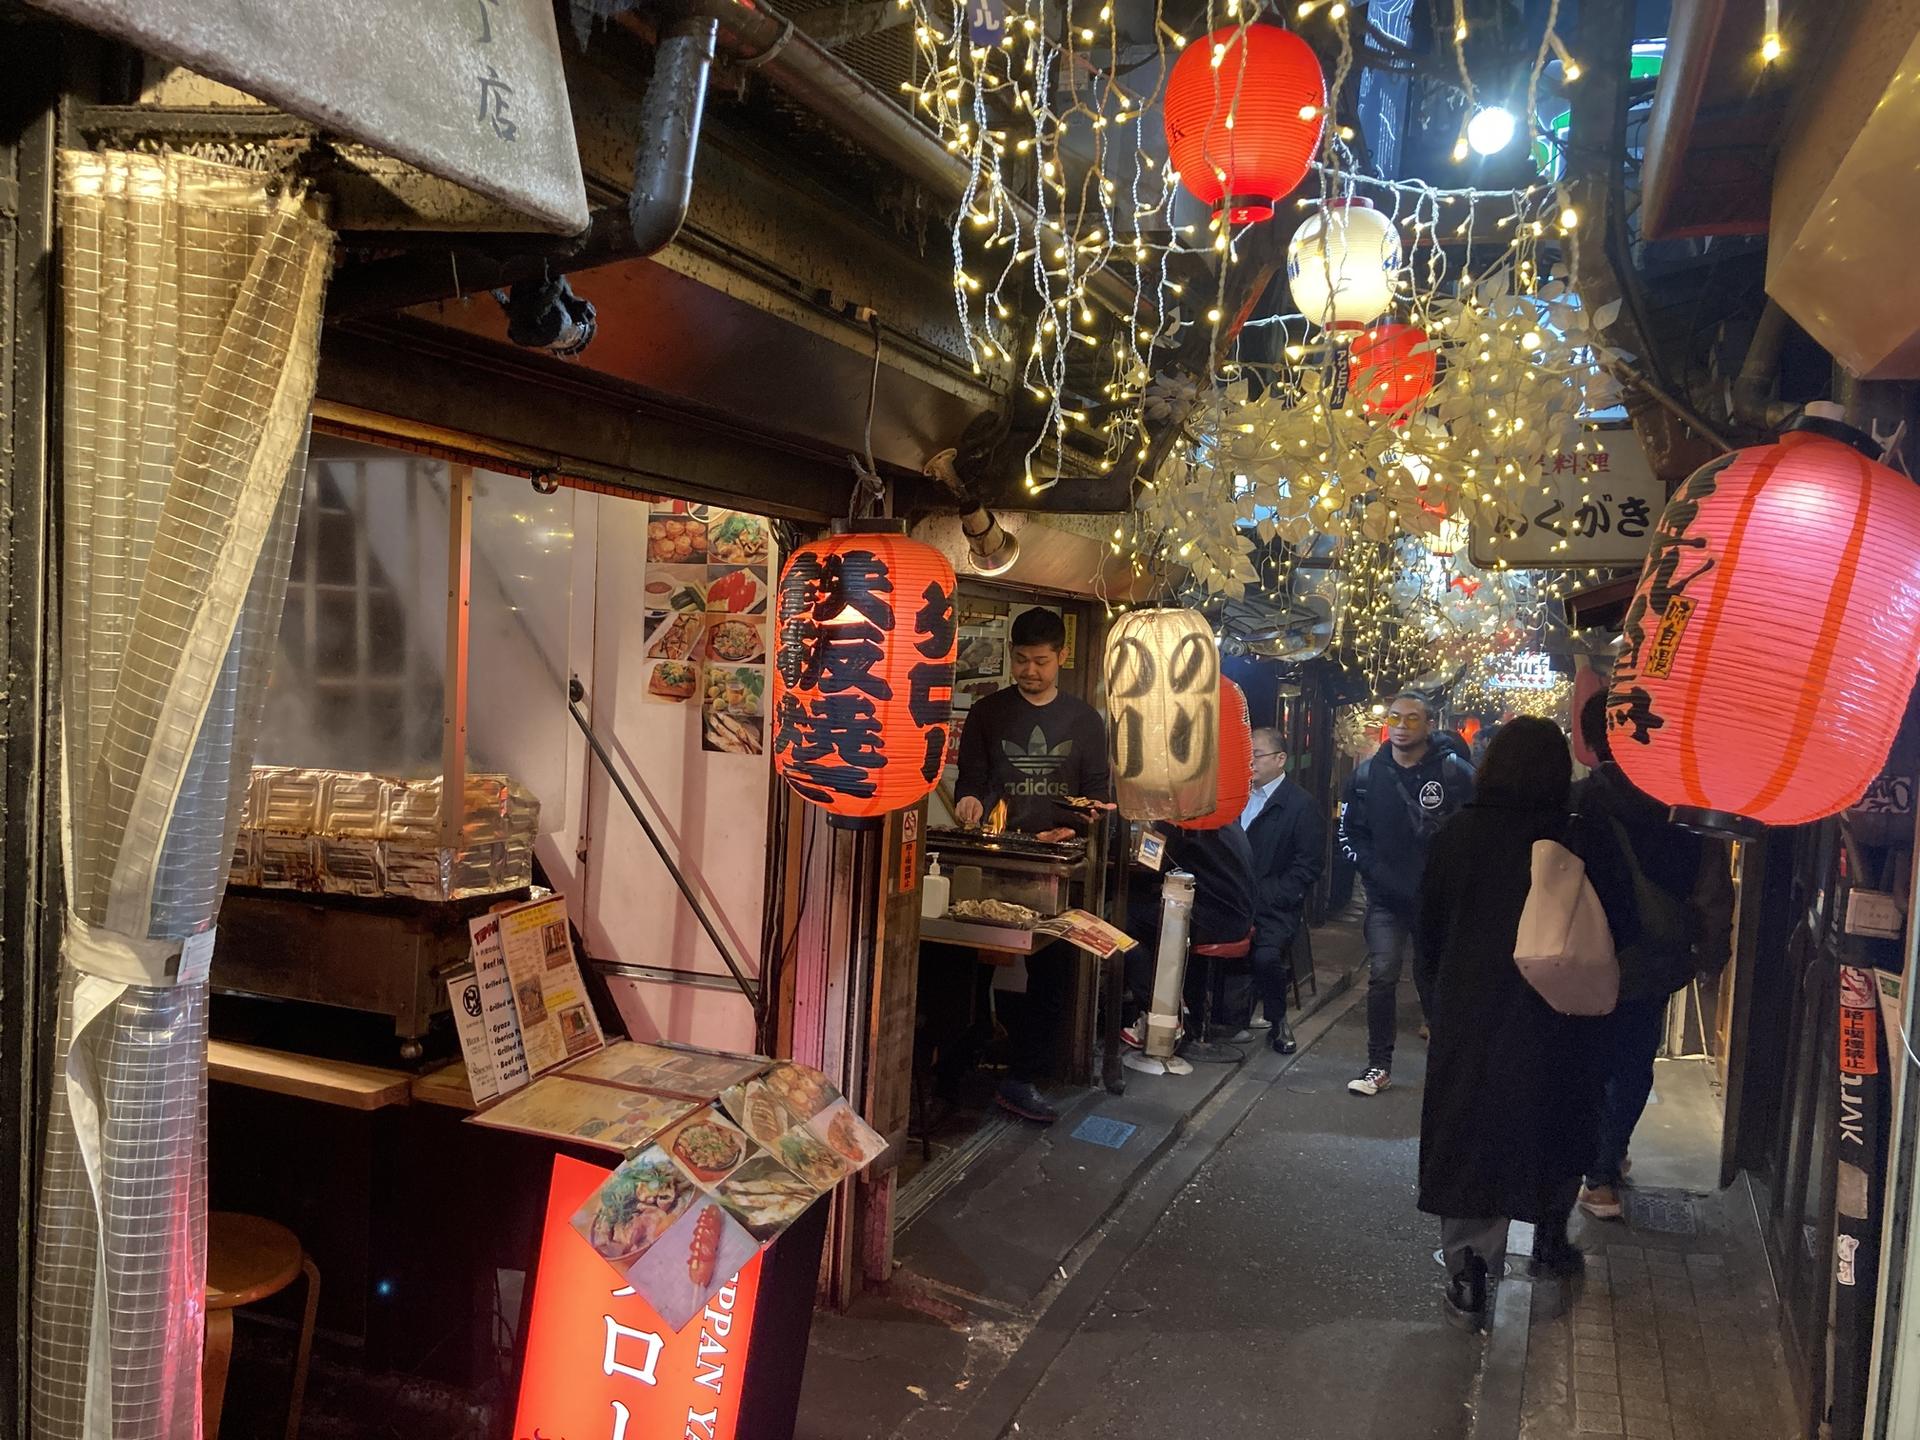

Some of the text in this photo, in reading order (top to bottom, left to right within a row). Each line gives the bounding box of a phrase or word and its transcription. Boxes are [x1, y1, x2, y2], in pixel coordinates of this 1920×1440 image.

[1004, 777, 1069, 796] adidas
[493, 1020, 510, 1034] Gyoza
[1844, 1009, 1866, 1069] 路上喫煙禁止
